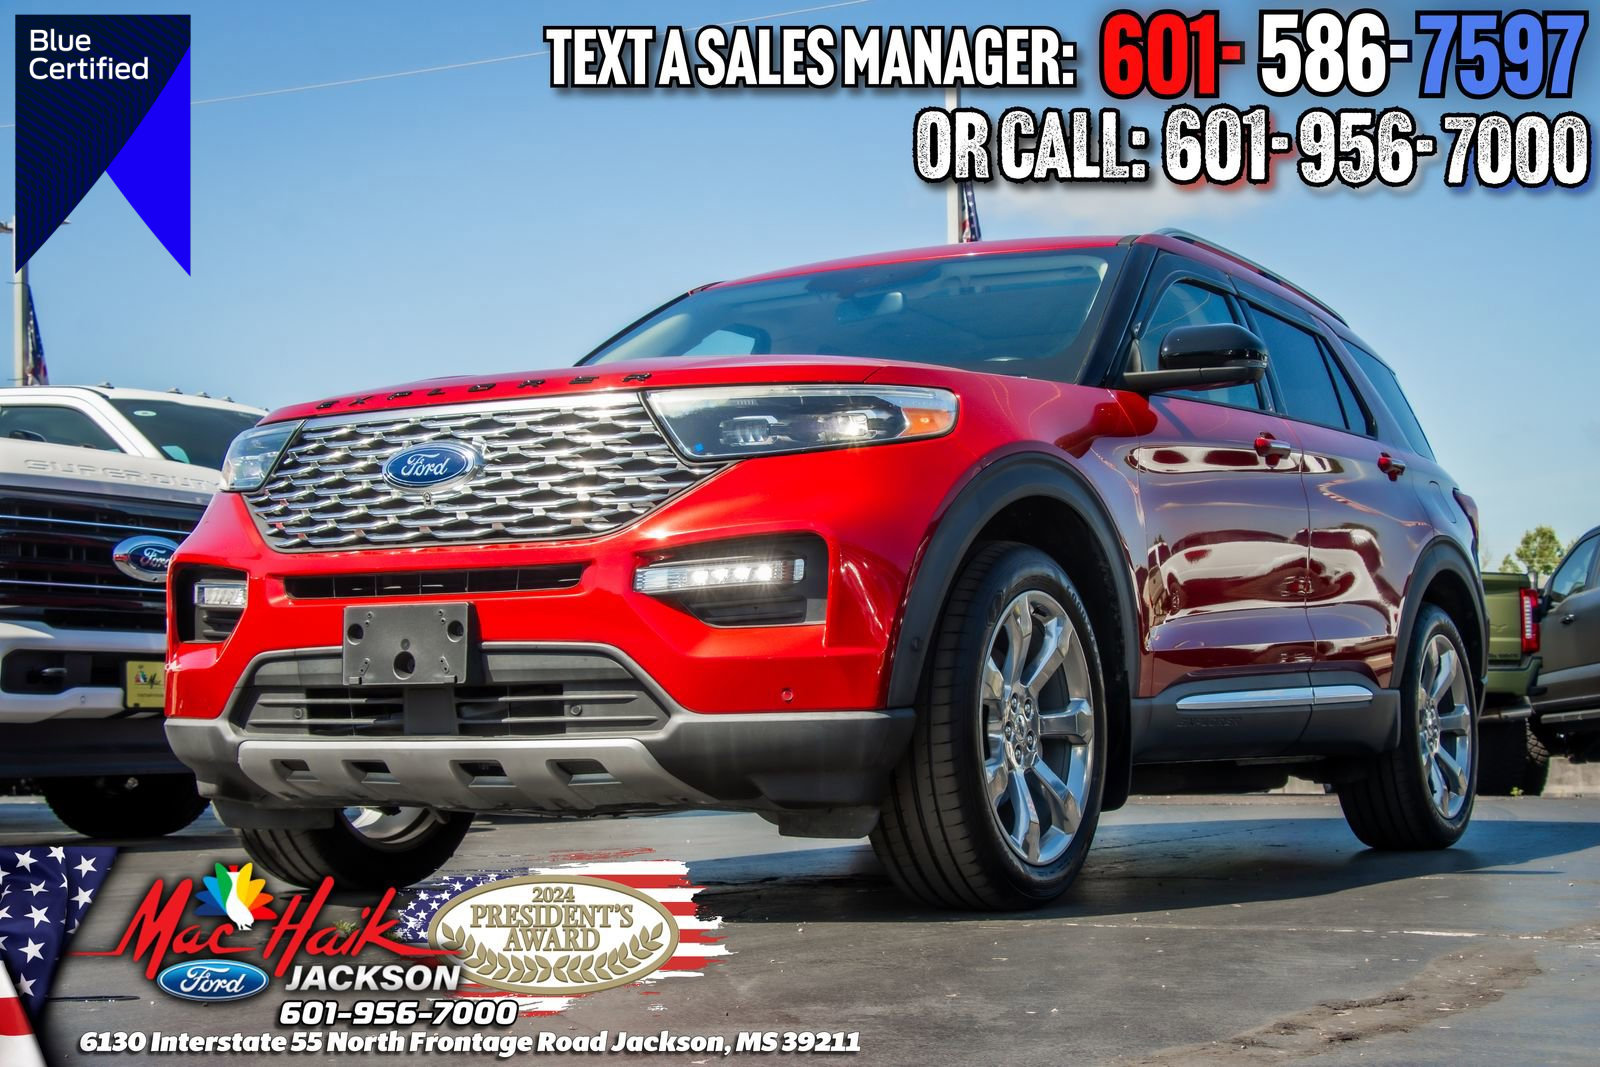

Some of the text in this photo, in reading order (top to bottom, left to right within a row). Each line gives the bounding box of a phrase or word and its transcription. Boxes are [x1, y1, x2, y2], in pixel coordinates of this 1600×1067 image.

[315, 372, 652, 410] EXPLORER
[24, 458, 143, 480] SUPER
[400, 453, 449, 477] Ford
